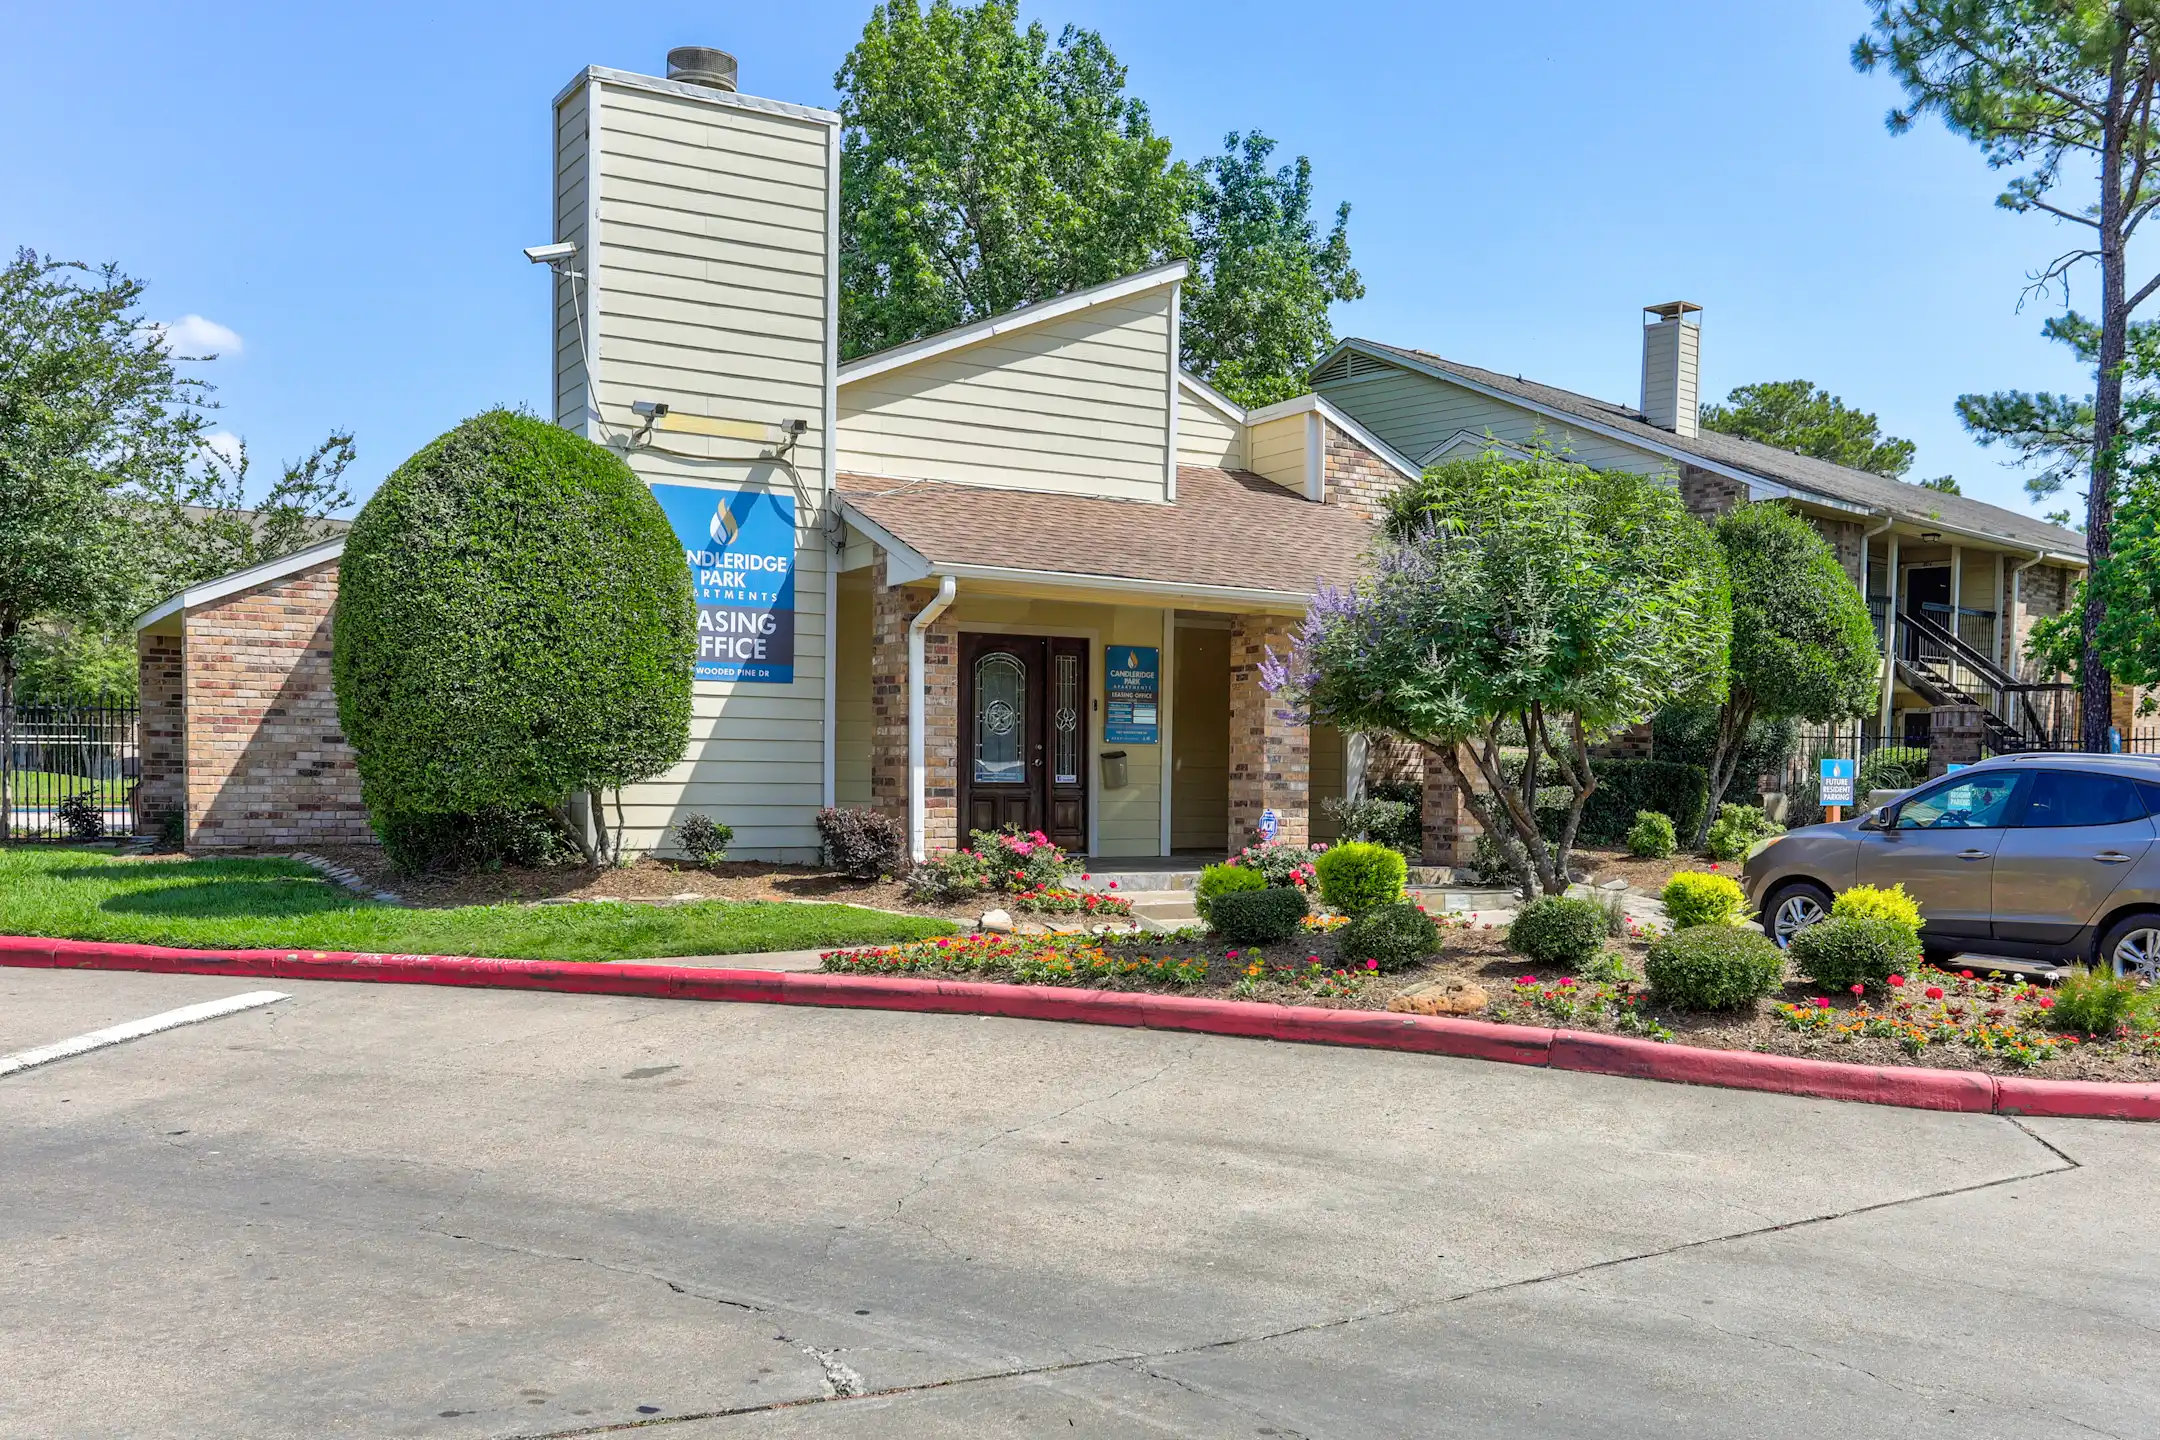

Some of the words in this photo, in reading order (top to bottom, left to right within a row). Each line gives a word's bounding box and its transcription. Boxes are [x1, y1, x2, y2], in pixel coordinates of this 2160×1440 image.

[686, 549, 787, 573] NDLERIDGE
[700, 569, 747, 588] PARK
[693, 588, 777, 602] ARTMENTS
[697, 609, 777, 635] ASING
[700, 635, 767, 660] FFICE
[696, 667, 735, 676] WOODED
[737, 668, 756, 677] PINE
[758, 669, 770, 677] DR
[1110, 669, 1155, 679] CANDLERIDGE
[1825, 778, 1849, 786] FUTURE
[1823, 793, 1850, 801] PARKING
